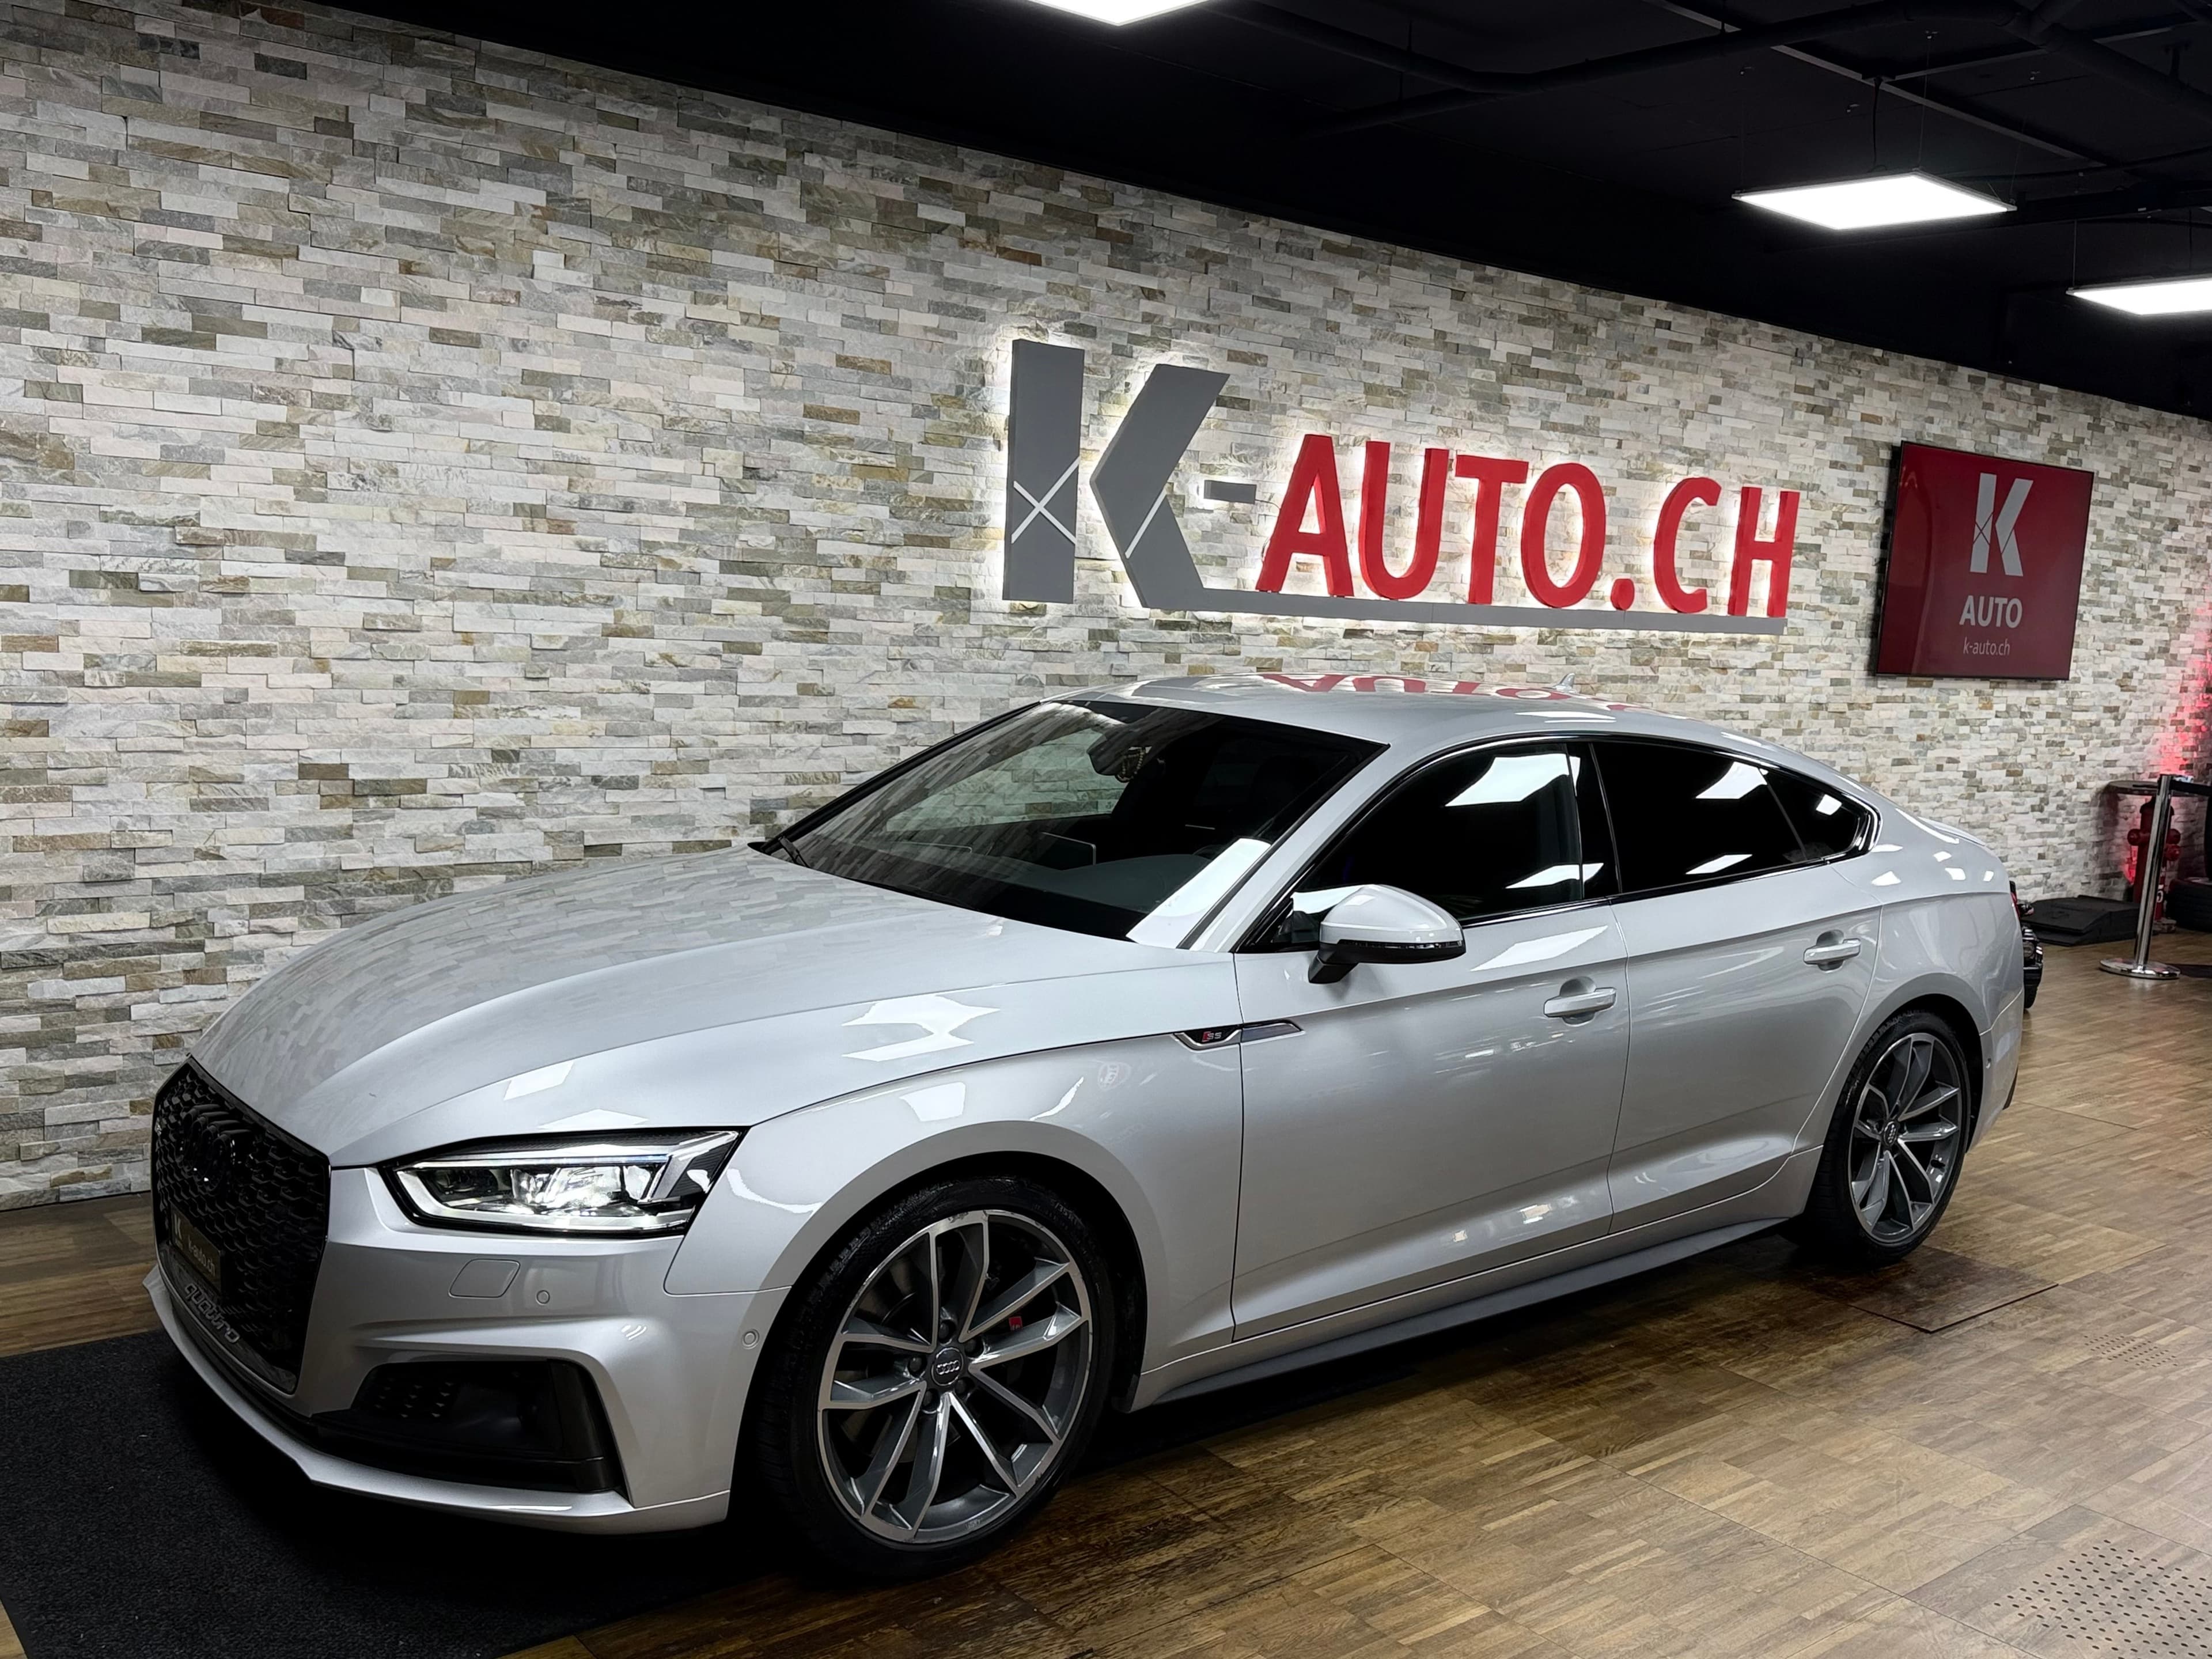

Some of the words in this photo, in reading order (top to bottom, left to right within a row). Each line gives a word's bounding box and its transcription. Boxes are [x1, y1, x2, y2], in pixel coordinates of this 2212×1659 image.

[1002, 339, 1801, 618] K-AUTO.CH
[1970, 472, 2033, 576] K
[1959, 595, 2022, 628] AUTO
[1963, 637, 2010, 656] k-auto.ch
[185, 1283, 240, 1343] quattro
